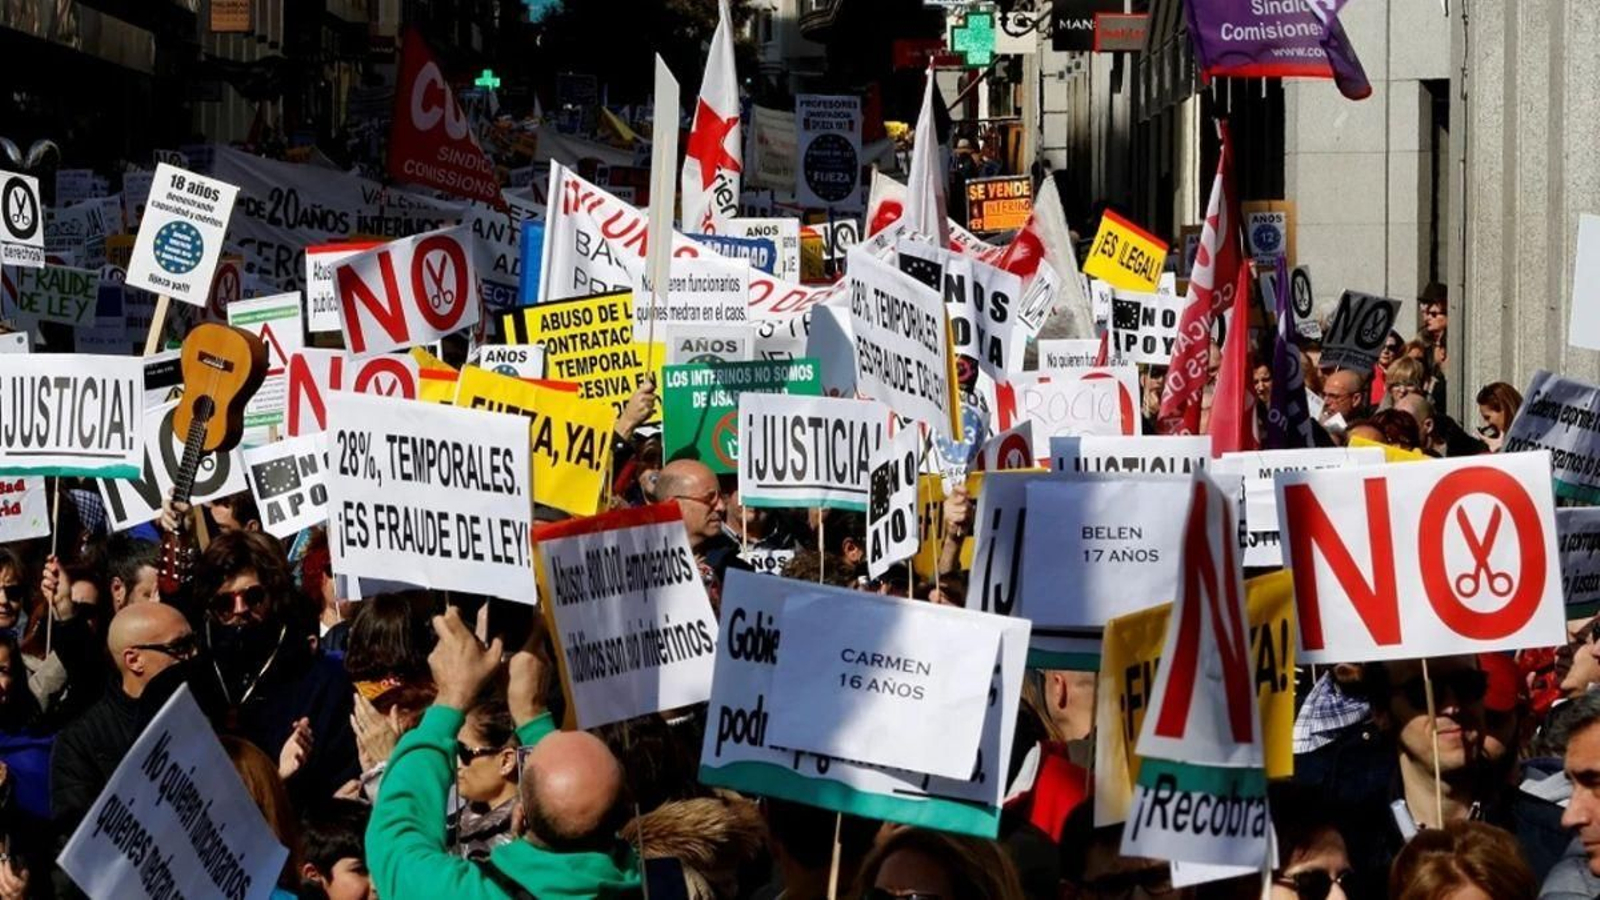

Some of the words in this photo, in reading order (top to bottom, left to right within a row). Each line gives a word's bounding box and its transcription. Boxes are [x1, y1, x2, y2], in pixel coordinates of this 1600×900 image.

[1059, 19, 1096, 30] MAN
[170, 174, 186, 192] 18
[187, 182, 220, 202] años
[403, 159, 497, 199] COMISSIONS
[969, 183, 986, 200] SE
[988, 180, 1031, 198] VENDE
[269, 188, 300, 229] 20
[299, 204, 350, 234] AÑOS
[746, 223, 779, 237] AÑOS
[1093, 231, 1118, 258] ¡ES
[1118, 240, 1161, 285] ILEGAL!
[19, 266, 98, 300] FRAUDE
[336, 235, 468, 354] NO
[688, 272, 740, 293] funcionarios
[20, 292, 43, 314] DE
[47, 295, 89, 323] LEY
[540, 307, 592, 332] ABUSO
[599, 302, 624, 324] DE
[670, 302, 700, 320] medran
[702, 307, 713, 321] en
[715, 302, 723, 320] el
[725, 305, 747, 321] caos.
[874, 288, 941, 358] TEMPORALES.
[1327, 293, 1393, 349] NO
[485, 347, 528, 363] AÑOS
[537, 326, 633, 355] CONTRATAC
[681, 339, 738, 353] AÑOS
[556, 350, 642, 378] TEMPORAL
[667, 371, 689, 388] LOS
[691, 367, 751, 386] INTERINOS
[754, 365, 771, 382] NO
[773, 365, 814, 382] SOMOS
[0, 374, 134, 451] JUSTICIA!
[693, 391, 707, 408] DE
[565, 421, 607, 471] YA!
[337, 430, 382, 487] 28%,
[386, 434, 521, 496] TEMPORALES.
[266, 482, 328, 526] APO
[338, 501, 369, 558] ¡ES
[374, 504, 451, 558] FRAUDE
[456, 513, 485, 562] DE
[491, 516, 531, 568] LEY!
[1082, 527, 1143, 541] BELEN
[626, 536, 692, 603] empleados
[1084, 551, 1104, 563] 17
[1109, 546, 1159, 563] AÑOS
[1284, 466, 1547, 650] NO
[728, 608, 780, 665] Gobie
[841, 648, 931, 676] CARMEN
[840, 673, 862, 690] 16
[868, 677, 925, 700] AÑOS
[142, 730, 168, 782] No
[1131, 773, 1266, 843] ¡Recobra
[93, 794, 153, 868] quienes
